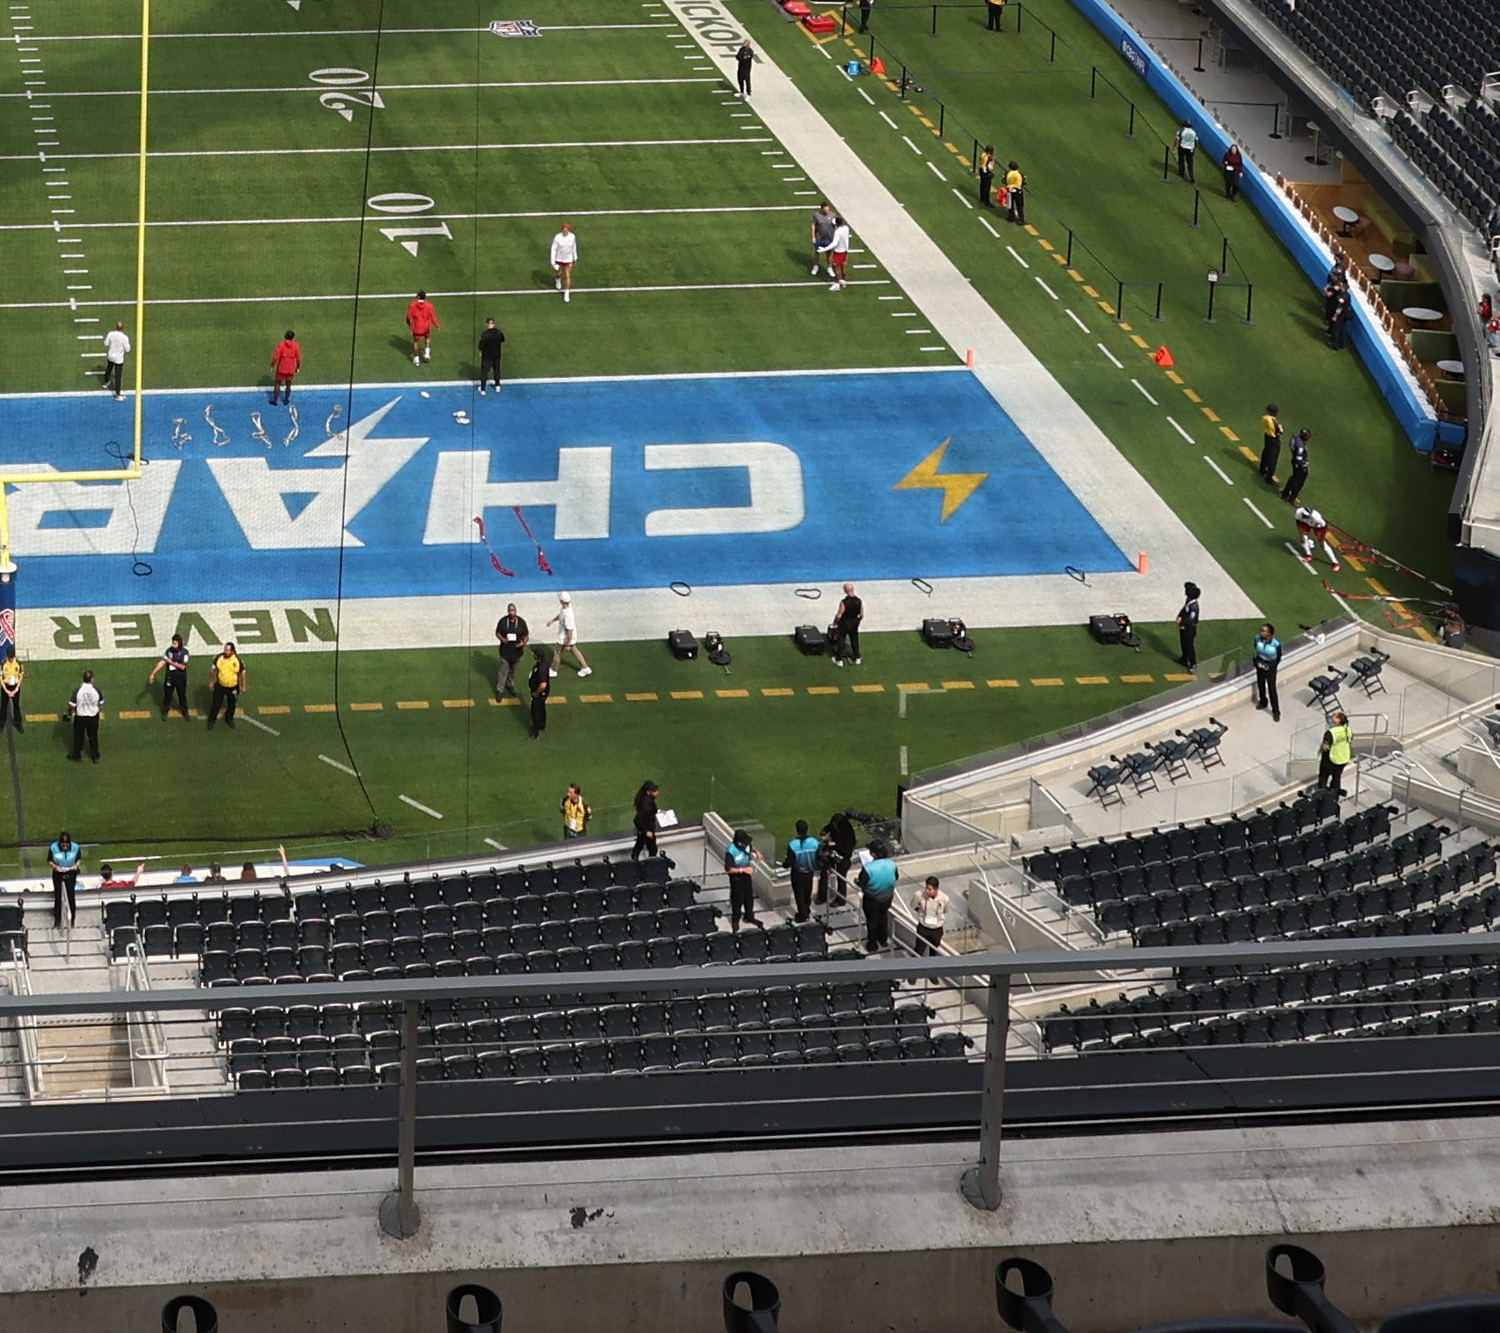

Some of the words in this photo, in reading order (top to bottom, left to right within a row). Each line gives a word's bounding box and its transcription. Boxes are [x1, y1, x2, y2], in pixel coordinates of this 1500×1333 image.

[308, 66, 387, 111] 20
[366, 192, 454, 243] 10
[50, 607, 338, 653] NEVER
